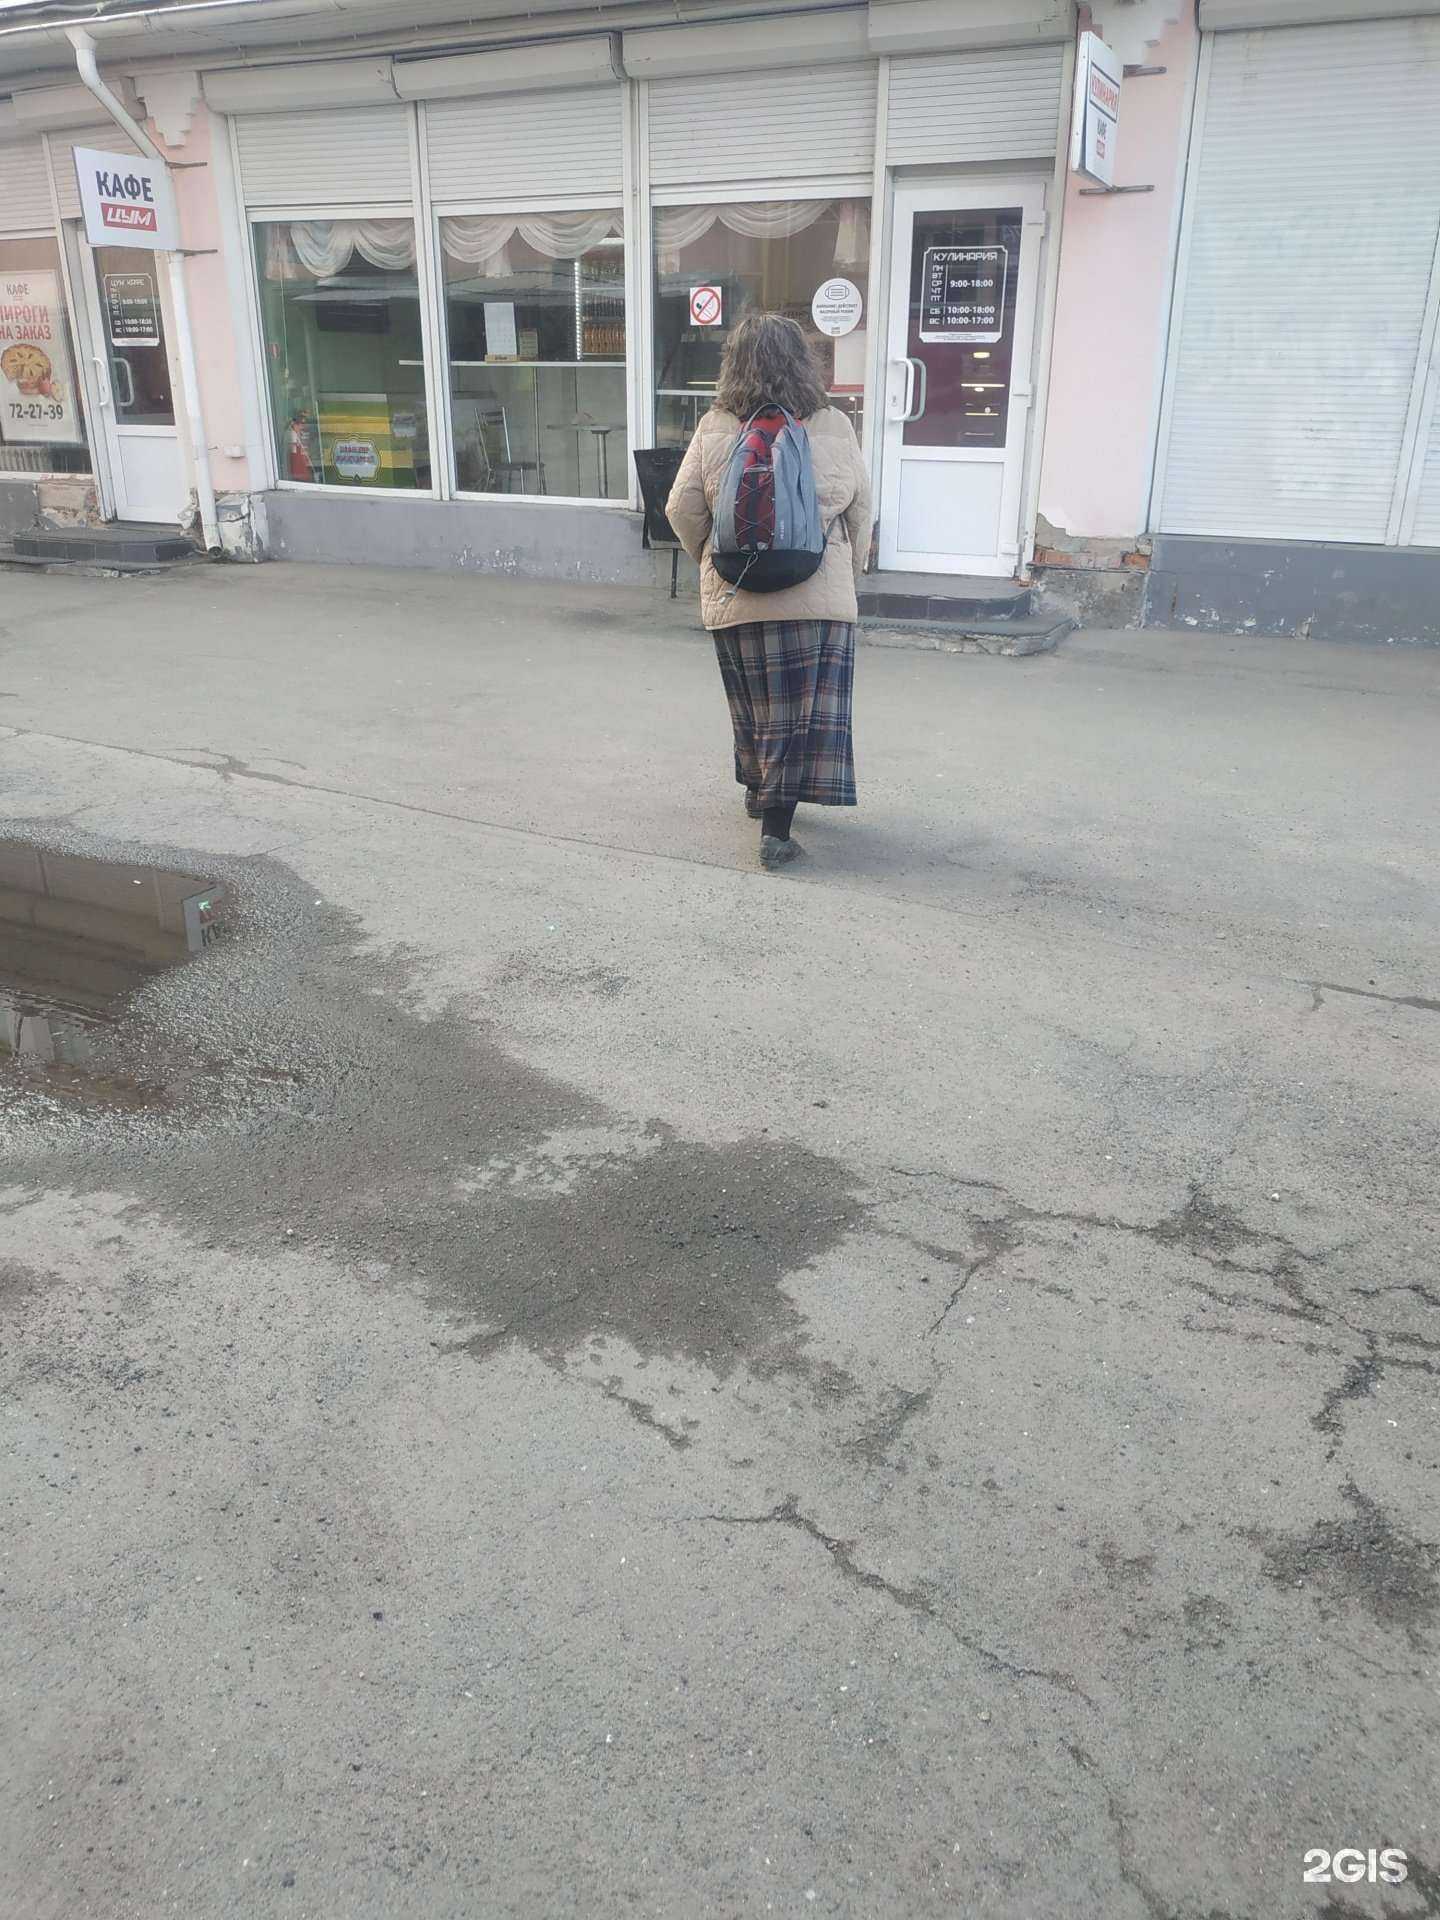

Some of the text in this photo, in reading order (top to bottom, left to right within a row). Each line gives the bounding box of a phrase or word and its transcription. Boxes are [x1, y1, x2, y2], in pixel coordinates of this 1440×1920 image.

[95, 170, 154, 203] КАФЕ
[106, 206, 153, 226] ЦУМ
[933, 251, 998, 262] КУЛИНАРИЯ
[932, 264, 944, 272] ПН
[6, 283, 30, 296] КАФЕ
[949, 280, 994, 288] 9:00-18:00
[947, 306, 995, 314] 10:00-18:00
[946, 316, 994, 325] 10:00-17:00
[15, 324, 52, 340] ЗАКАЗ
[9, 403, 64, 420] 72-27-39
